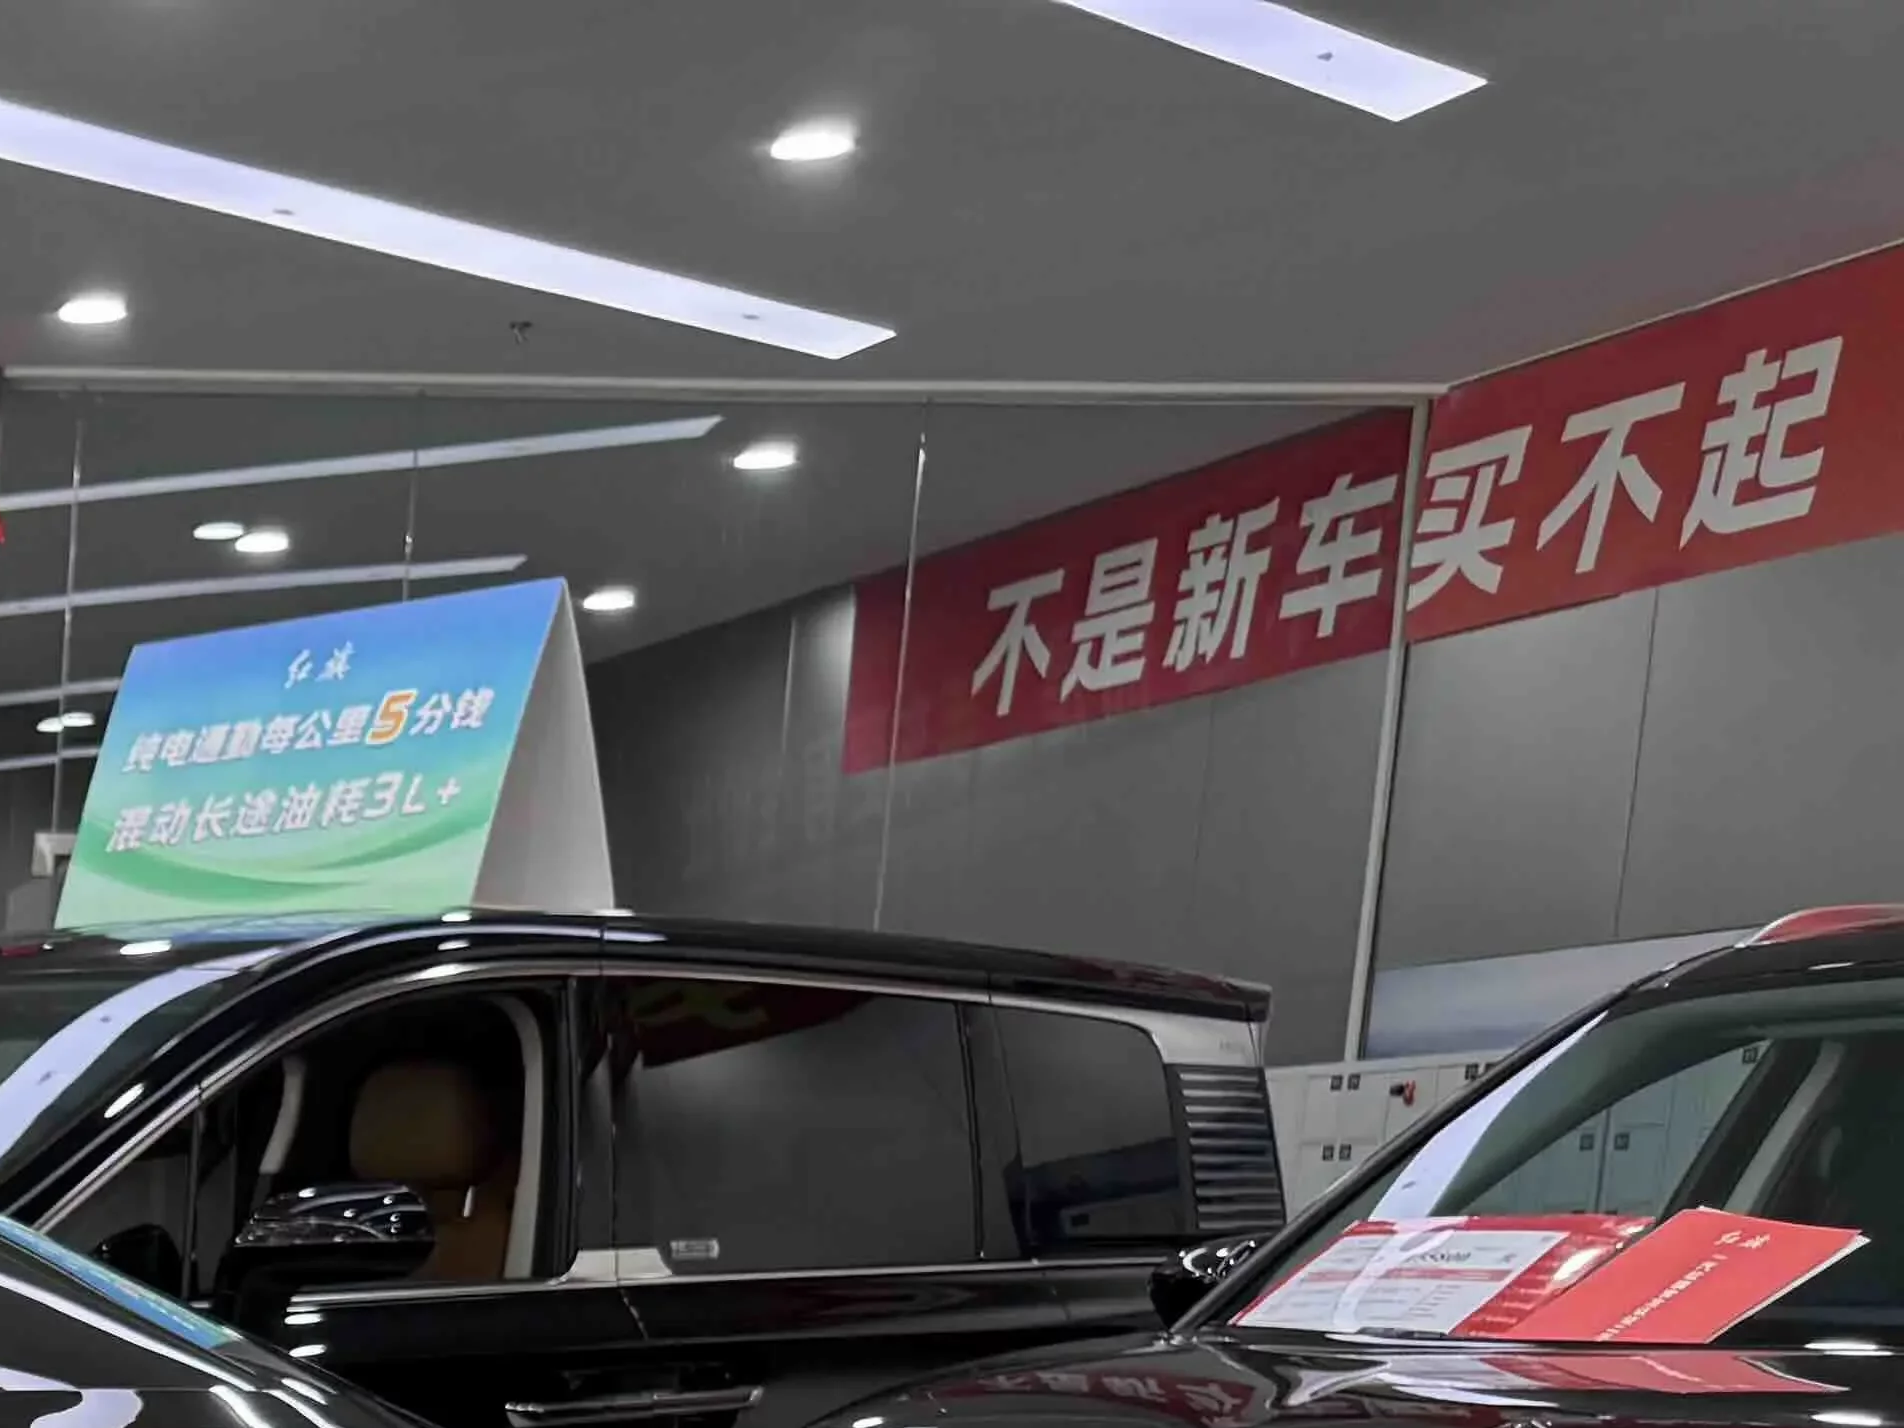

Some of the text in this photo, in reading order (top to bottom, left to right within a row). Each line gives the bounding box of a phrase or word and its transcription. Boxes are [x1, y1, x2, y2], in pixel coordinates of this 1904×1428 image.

[971, 336, 1844, 717] 不是新车买不起
[122, 687, 494, 773] 纯电通勤每公里5分钱
[106, 771, 462, 853] 混动长途油耗3L+
